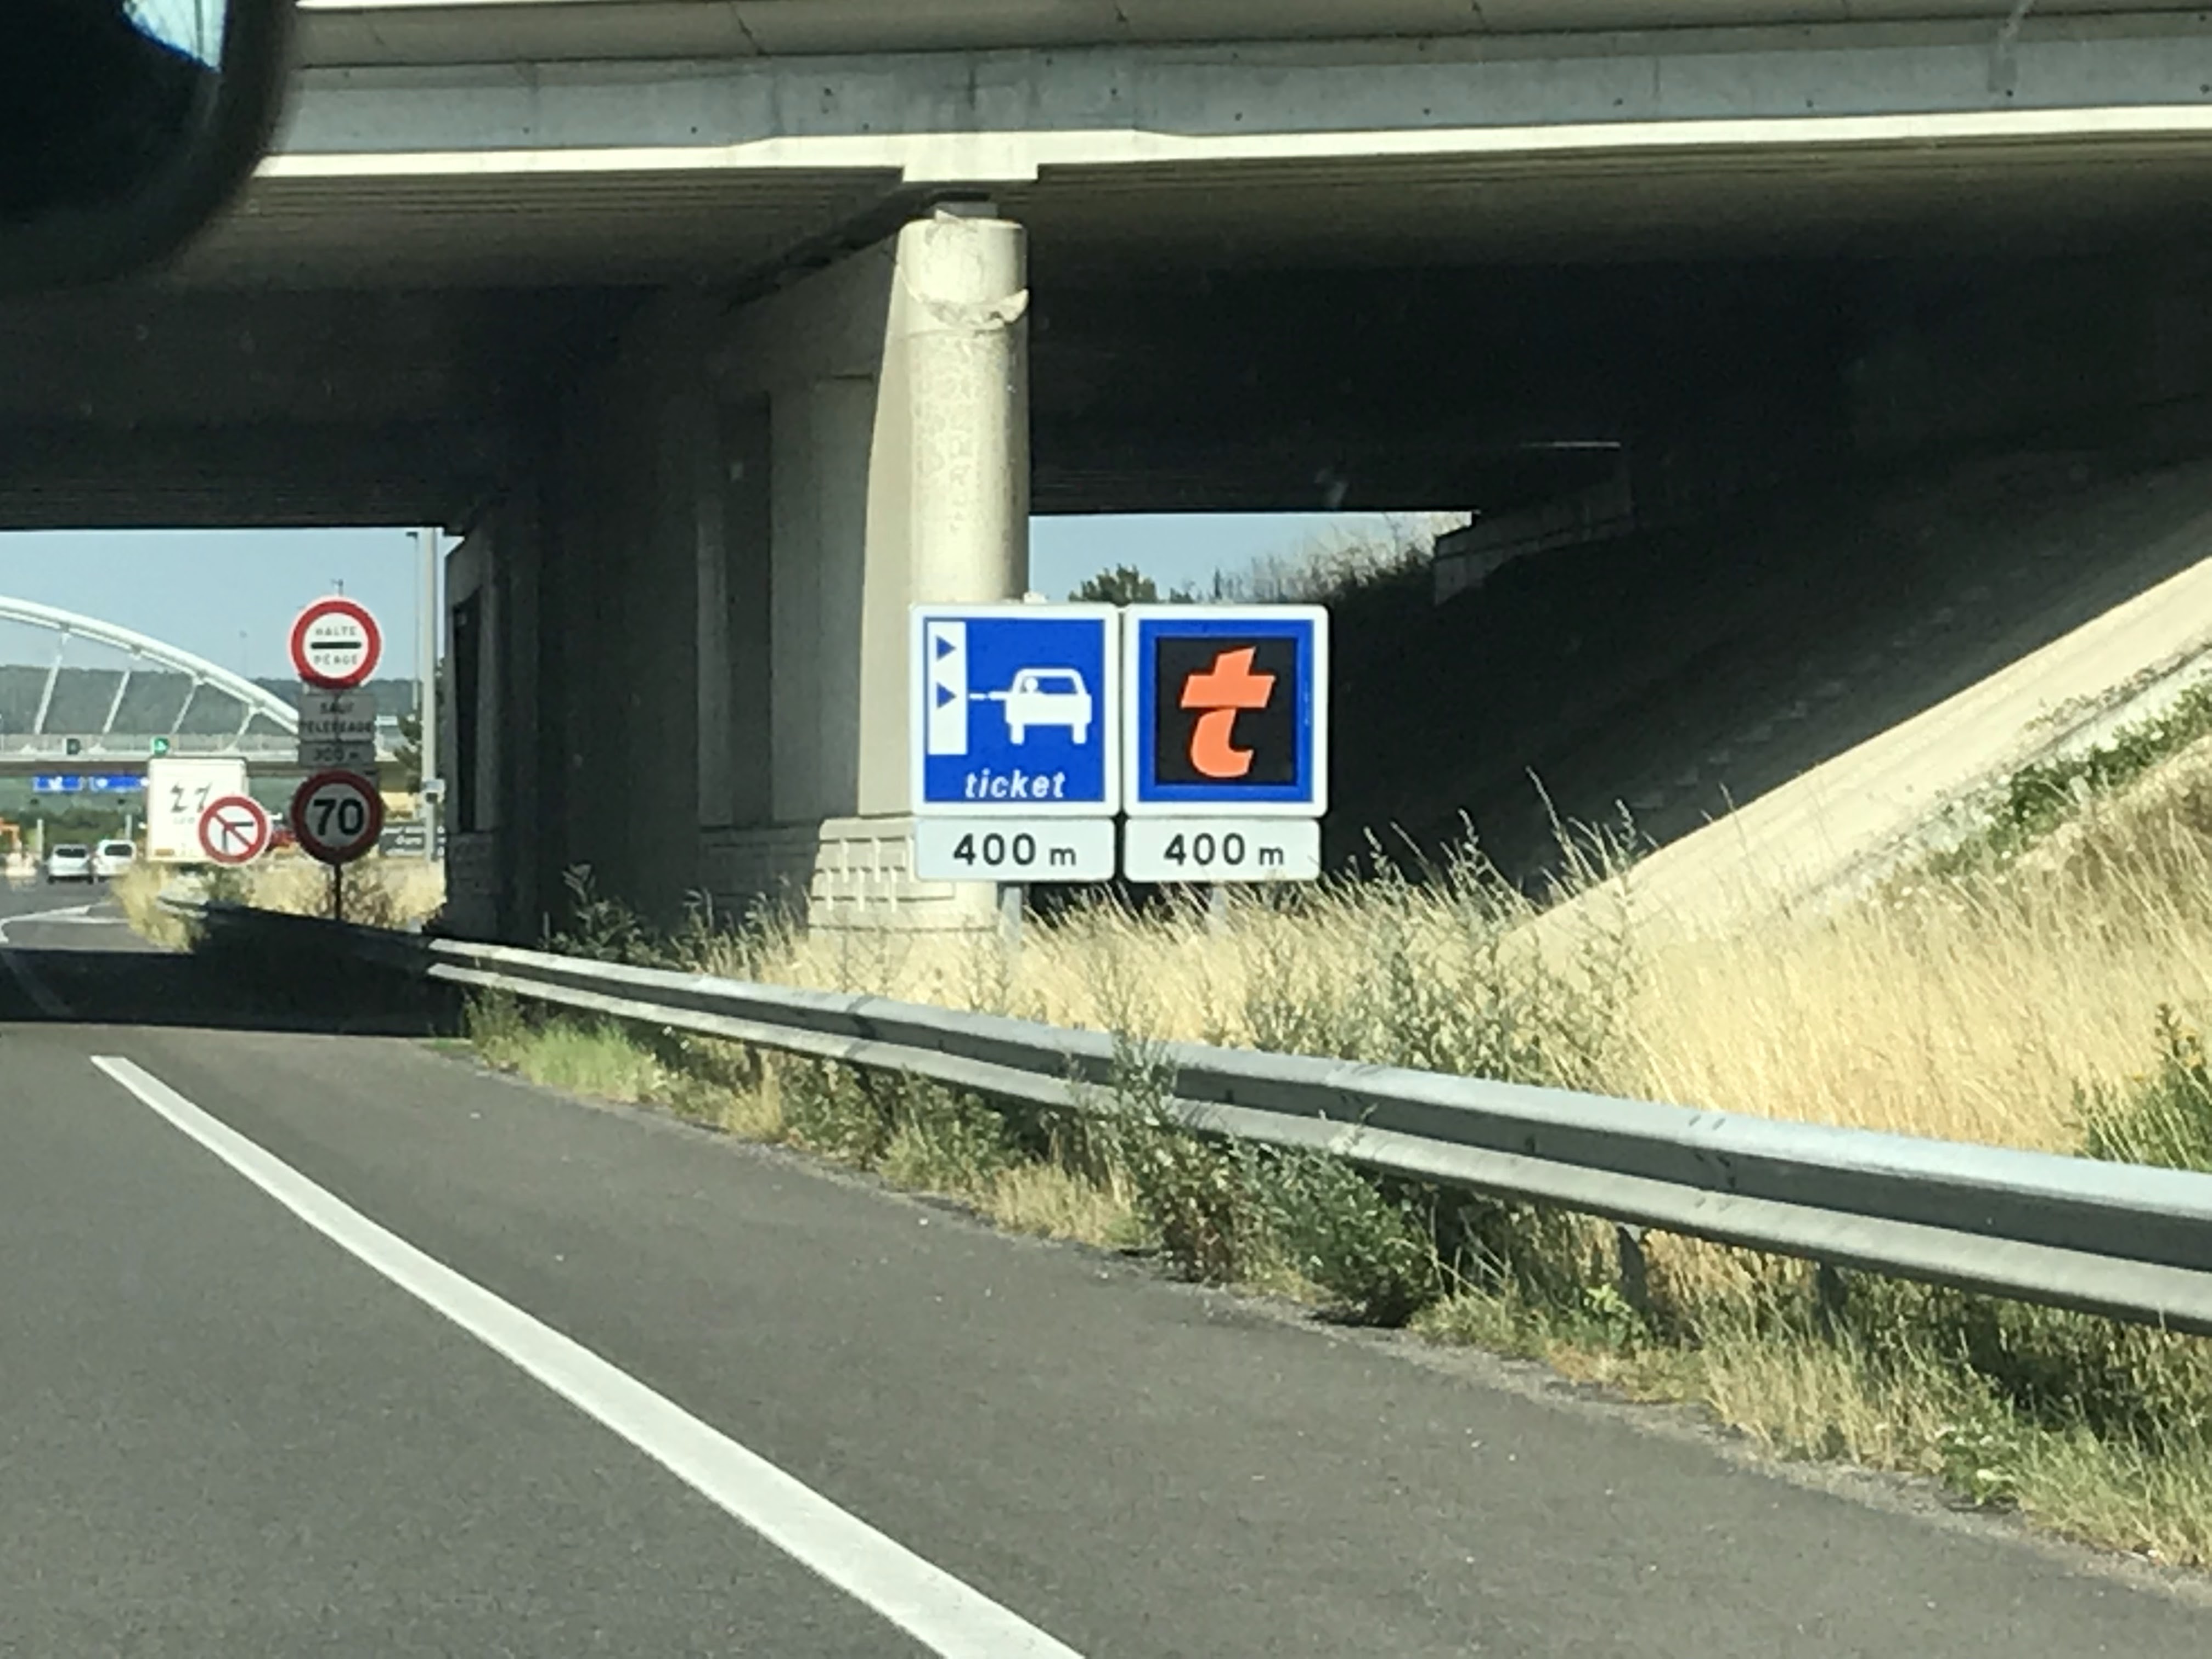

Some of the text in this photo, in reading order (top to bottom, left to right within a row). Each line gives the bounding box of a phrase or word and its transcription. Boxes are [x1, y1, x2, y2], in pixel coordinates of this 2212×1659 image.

[315, 626, 356, 636] HALTE
[965, 768, 1066, 798] ticket
[313, 799, 364, 836] 70
[953, 832, 1077, 866] 400 m
[1164, 832, 1284, 866] 400 m
